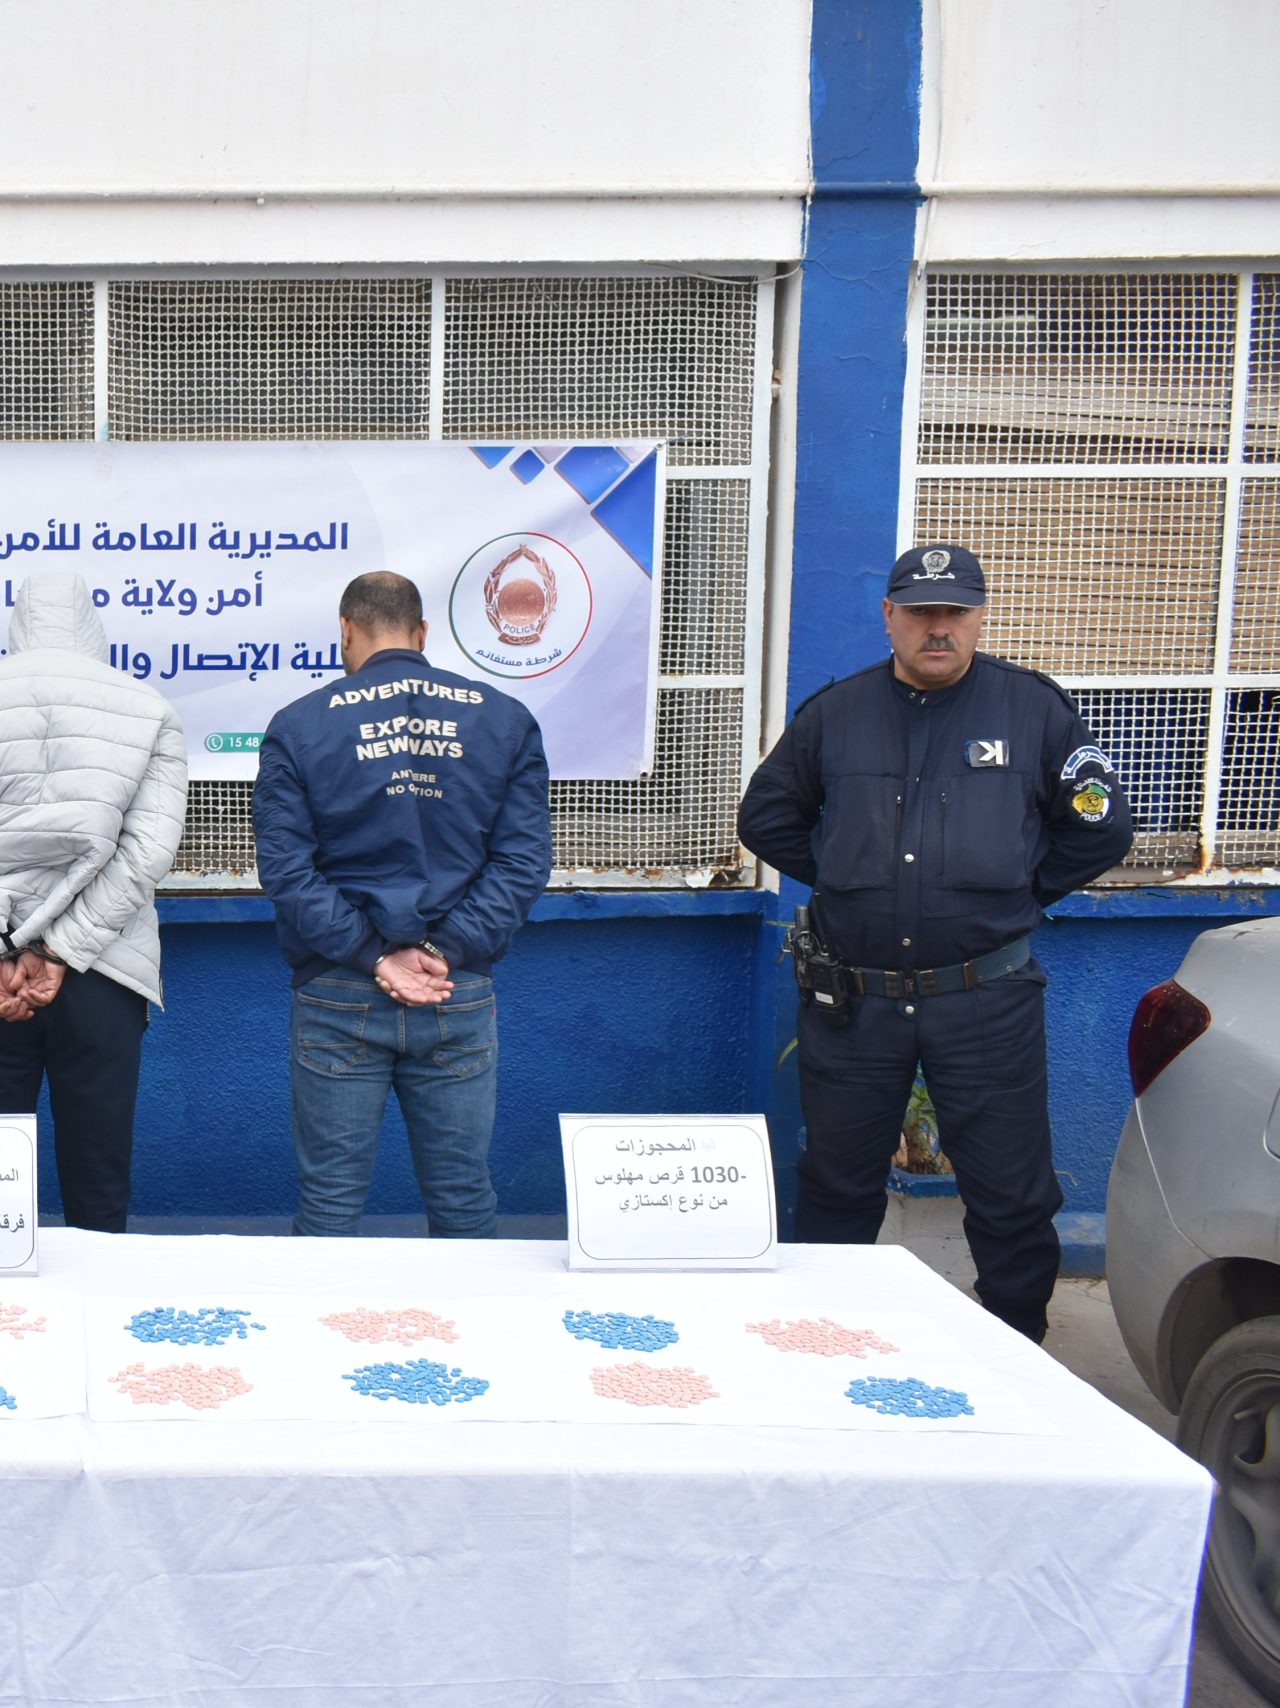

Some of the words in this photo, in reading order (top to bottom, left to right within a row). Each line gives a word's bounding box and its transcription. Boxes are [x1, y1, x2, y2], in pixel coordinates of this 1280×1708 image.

[92, 522, 197, 551] العامة
[208, 521, 348, 559] المديرية
[121, 578, 197, 616] ولاية
[205, 571, 263, 616] أمن
[503, 623, 536, 635] POLICE
[160, 642, 280, 681] الإتصال
[290, 642, 346, 679] لية
[475, 649, 523, 666] مستغانم
[525, 648, 562, 666] شرطة
[329, 679, 484, 708] ADVENTURES
[359, 715, 458, 740] EXPORE
[229, 737, 242, 748] 15
[245, 737, 260, 748] 48
[386, 784, 406, 796] NO
[408, 783, 443, 799] OTION
[616, 1138, 696, 1155] المحجوزات
[595, 1168, 643, 1185] مهلوس
[649, 1166, 684, 1184] قرص
[619, 1194, 672, 1213] إكستازي
[678, 1194, 703, 1212] نوع
[709, 1196, 728, 1209] من
